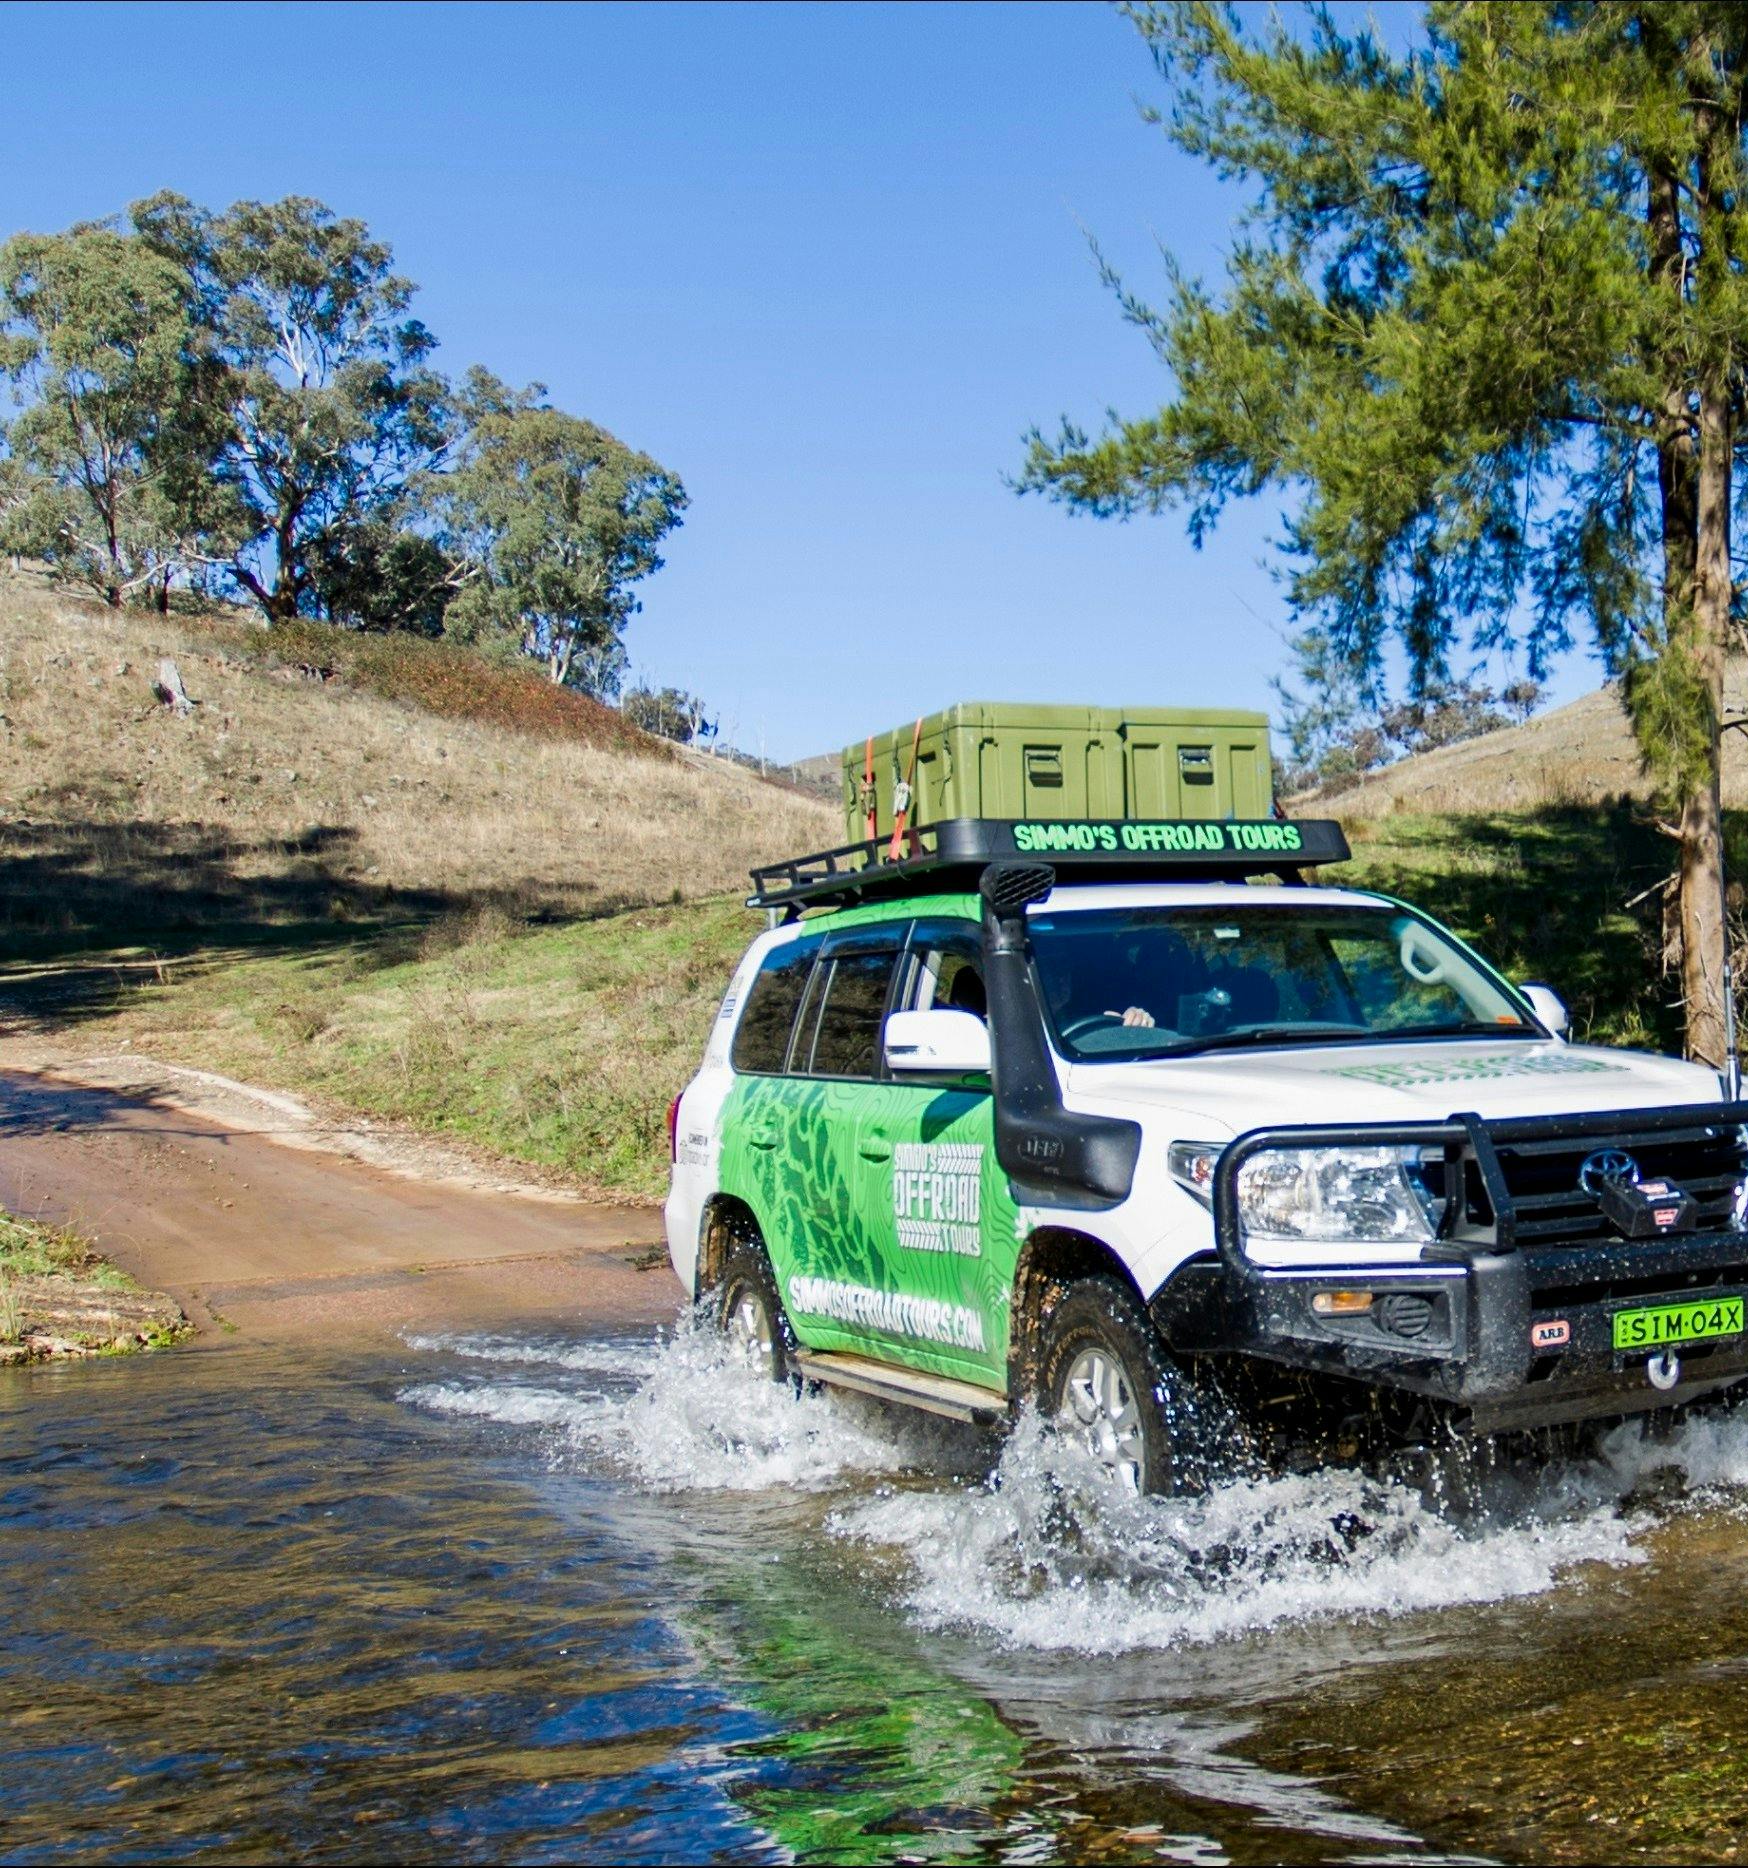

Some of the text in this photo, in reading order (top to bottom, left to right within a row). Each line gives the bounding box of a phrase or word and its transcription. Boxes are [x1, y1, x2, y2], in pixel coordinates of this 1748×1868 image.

[1013, 824, 1302, 850] SIMMO'S OFFROAD TOURS
[894, 1171, 981, 1223] OFFROAD
[940, 1223, 981, 1257] TOURS
[1539, 1327, 1564, 1340] ARB
